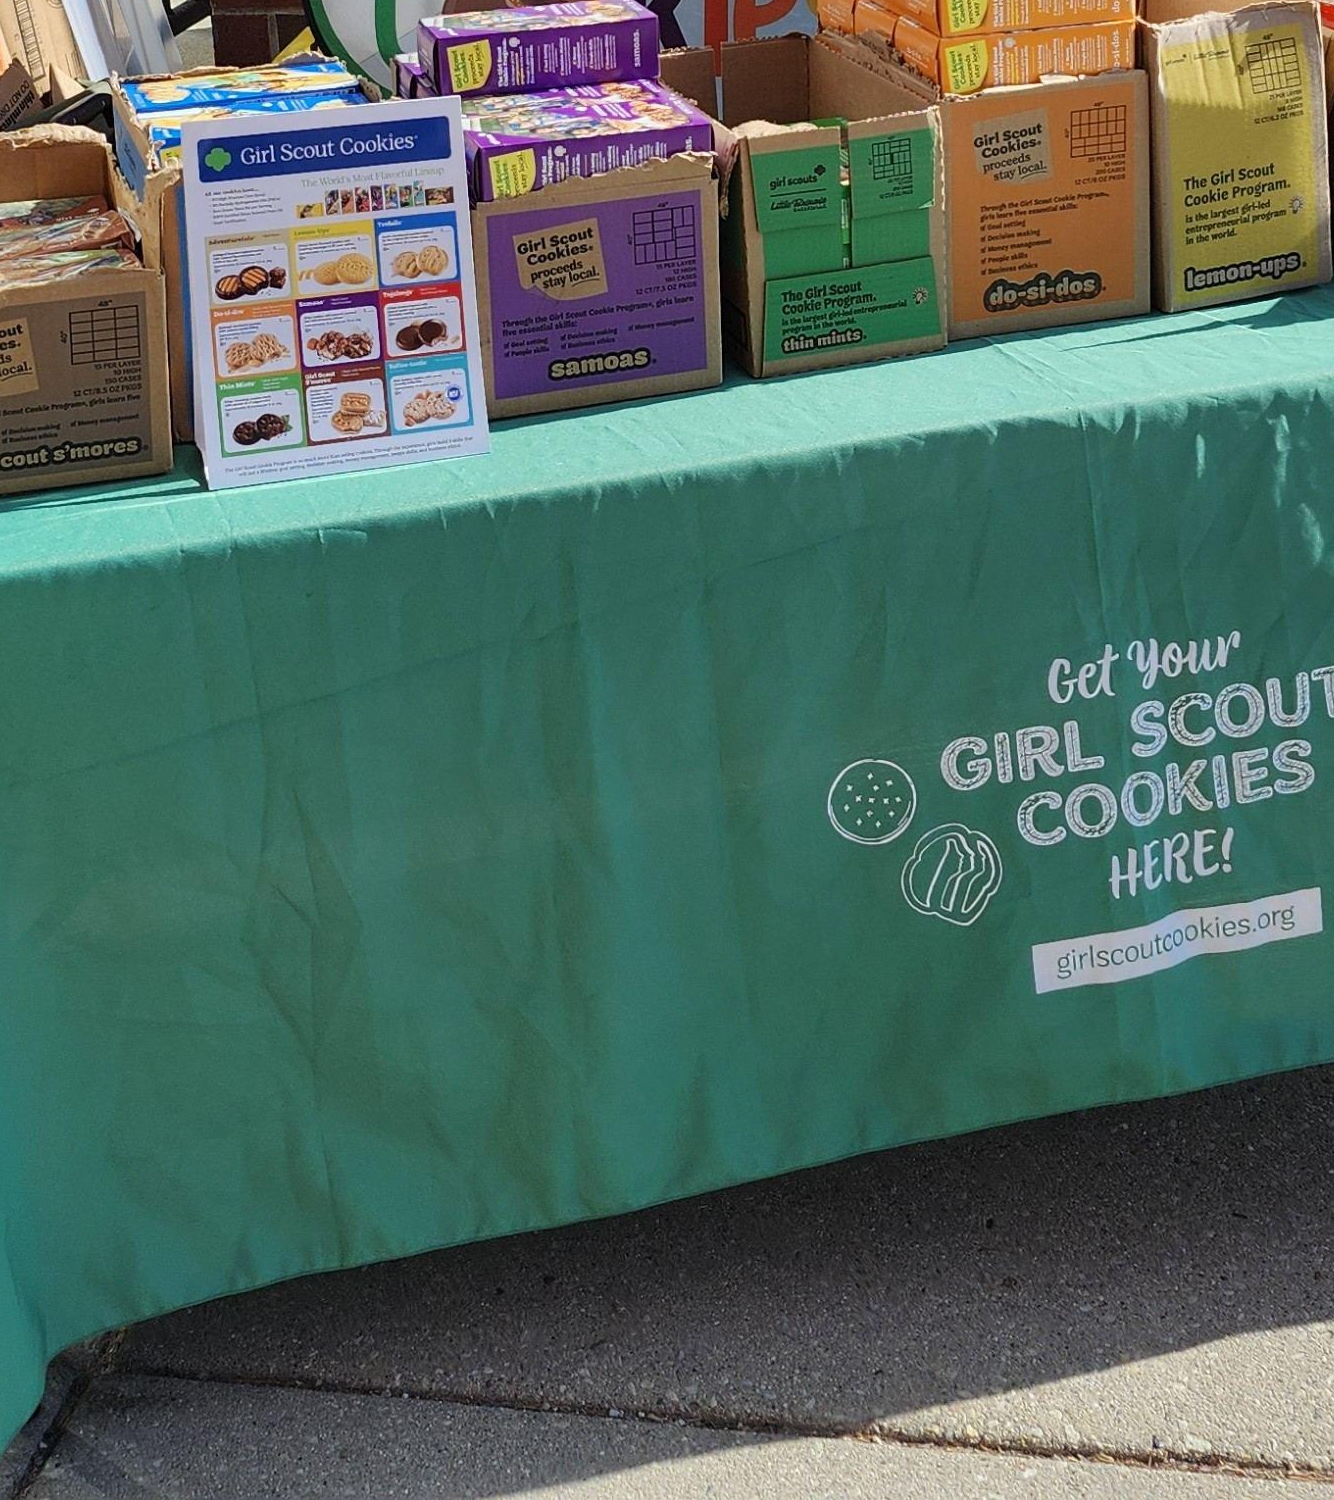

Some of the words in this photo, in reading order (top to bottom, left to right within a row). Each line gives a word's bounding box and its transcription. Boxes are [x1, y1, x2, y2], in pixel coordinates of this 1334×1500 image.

[974, 132, 999, 148] Girl
[1003, 123, 1042, 141] Scout
[240, 144, 275, 165] Girl
[280, 140, 335, 162] Scout
[983, 153, 1031, 174] proceeds
[770, 176, 785, 190] girl
[788, 174, 817, 186] scouts
[994, 169, 1016, 181] stay
[1018, 161, 1047, 175] local.
[1183, 176, 1207, 190] The
[1211, 169, 1234, 186] Girl
[1238, 163, 1275, 180] Scout
[301, 179, 317, 188] The
[1184, 188, 1228, 207] Cookie
[1185, 215, 1193, 223] is
[1195, 212, 1208, 221] the
[1211, 206, 1239, 219] largest
[1241, 199, 1271, 215] girl-led
[1185, 216, 1250, 235] entrepreneurial
[1252, 209, 1287, 224] program
[517, 237, 546, 255] Girl
[549, 227, 593, 247] Scout
[1186, 236, 1193, 245] in
[1196, 234, 1210, 242] the
[1211, 228, 1237, 240] world.
[531, 259, 583, 283] proceeds
[543, 275, 566, 288] stay
[569, 266, 599, 282] local.
[1187, 255, 1298, 288] lemon-ups
[781, 290, 803, 302] The
[805, 285, 827, 299] Girl
[829, 281, 863, 295] Scout
[989, 277, 1096, 306] do-si-dos
[782, 300, 822, 315] Cookie
[802, 313, 827, 323] largest
[828, 308, 853, 319] girl-led
[854, 299, 907, 315] entrepreneurial
[782, 325, 812, 336] program
[822, 320, 834, 328] the
[783, 336, 814, 352] thin
[817, 330, 861, 346] mints
[551, 350, 648, 378] samoas
[1048, 646, 1116, 704] Get
[1128, 630, 1241, 690] Your
[939, 720, 1105, 791] GIRL
[1016, 739, 1316, 848] COOKIES
[1109, 827, 1235, 900] HERE!
[1056, 903, 1297, 979] girlscoutcookies.org
